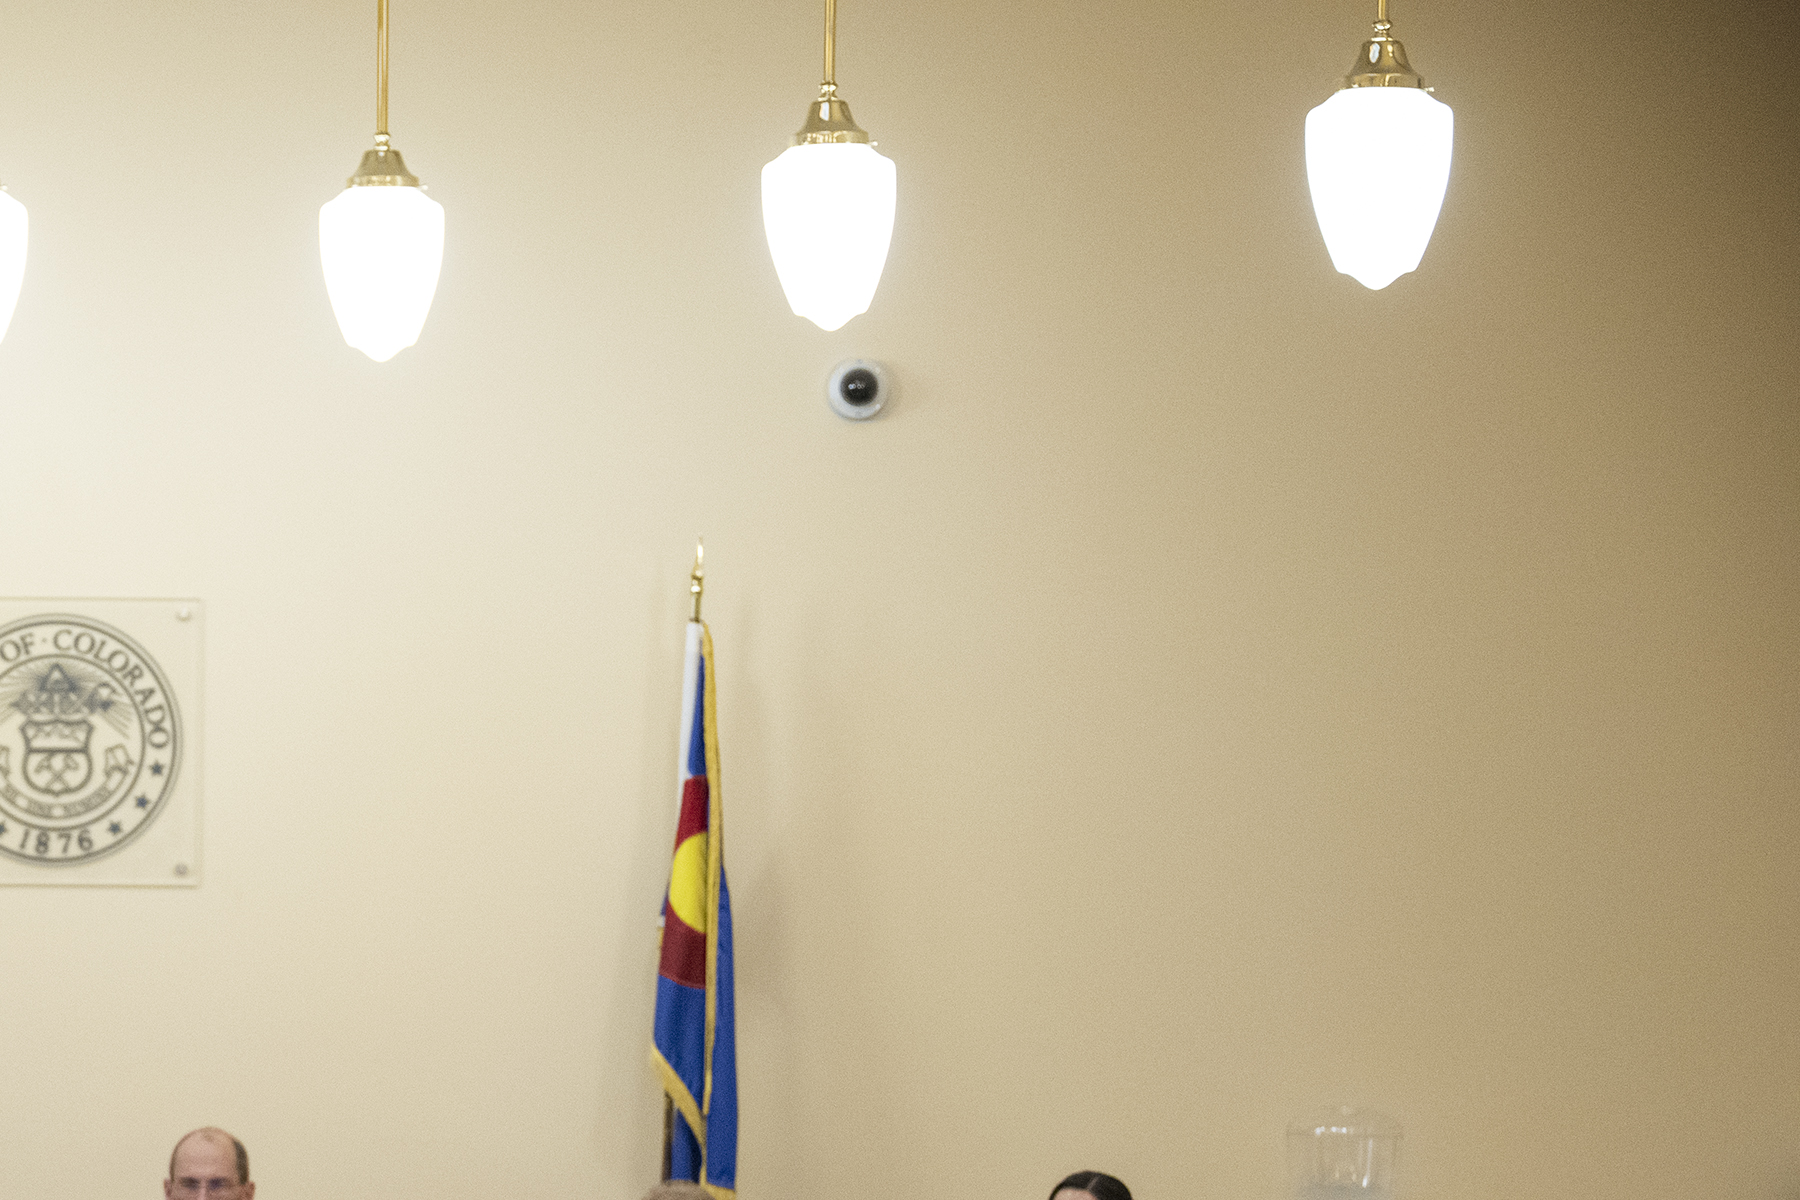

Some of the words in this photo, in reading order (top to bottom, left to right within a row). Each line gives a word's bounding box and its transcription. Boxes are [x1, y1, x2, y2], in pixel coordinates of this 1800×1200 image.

[0, 632, 36, 663] OF
[53, 629, 170, 749] COLORADO
[19, 828, 93, 854] 1876
